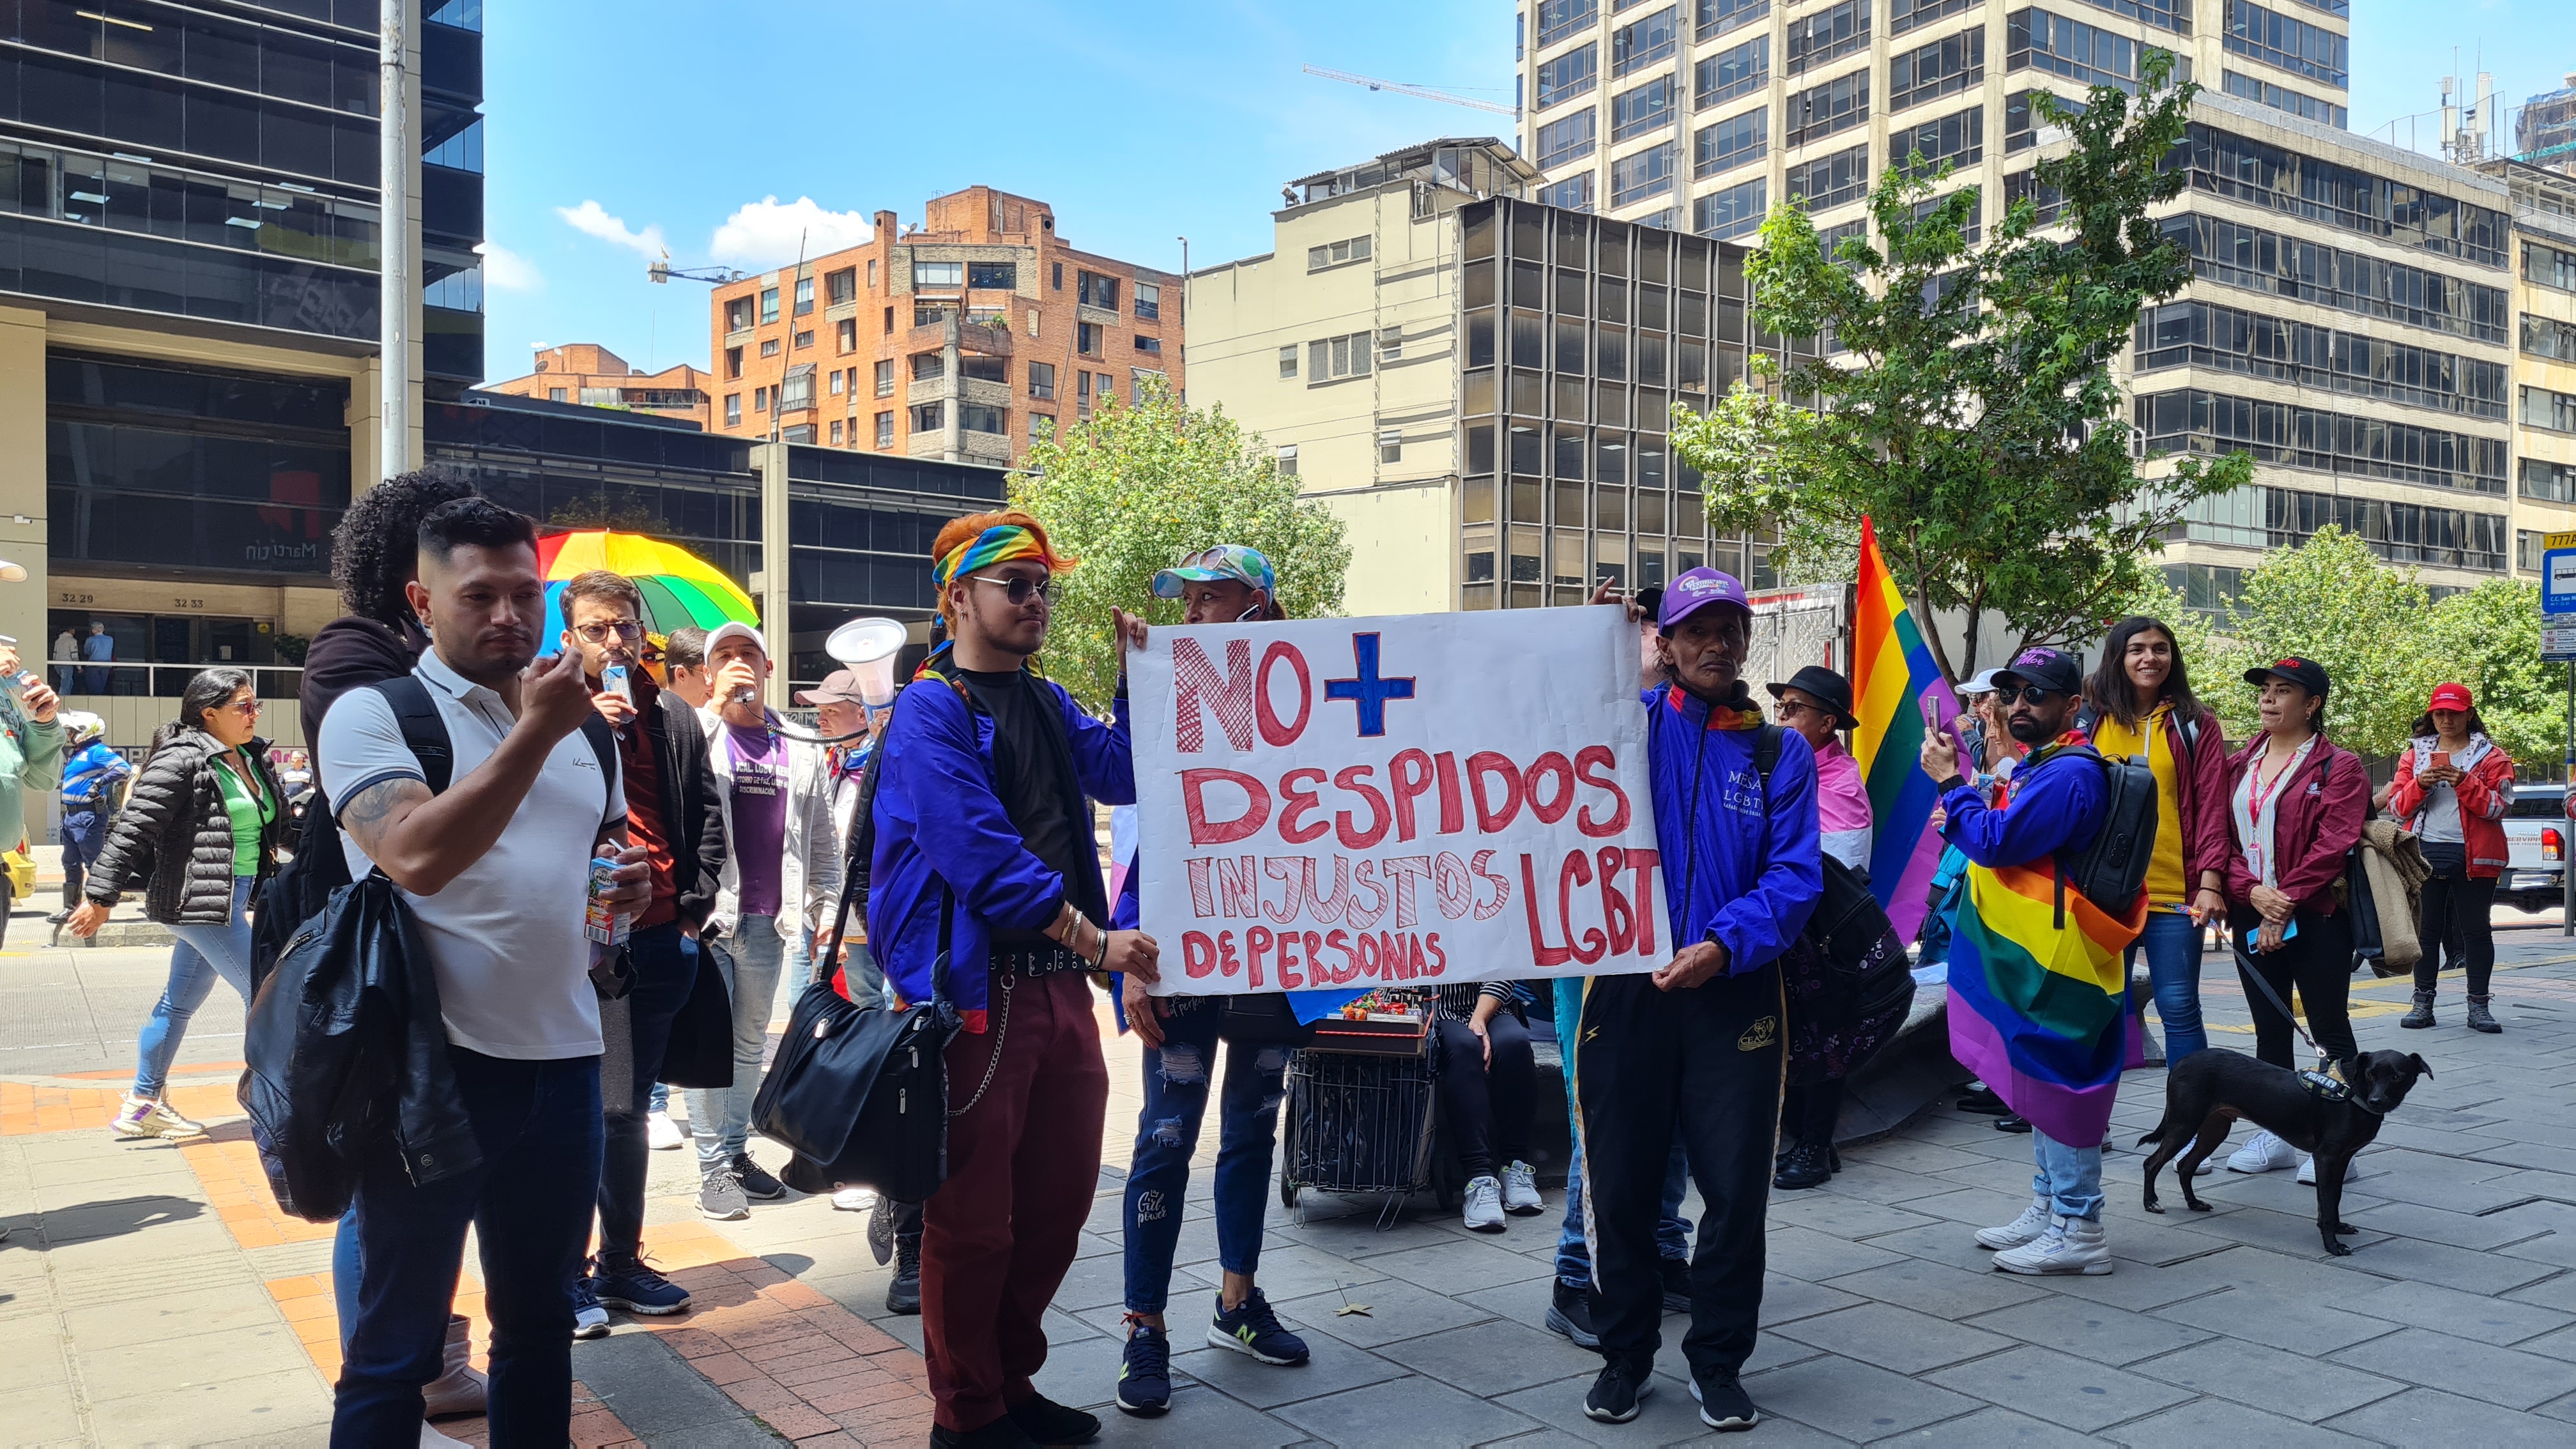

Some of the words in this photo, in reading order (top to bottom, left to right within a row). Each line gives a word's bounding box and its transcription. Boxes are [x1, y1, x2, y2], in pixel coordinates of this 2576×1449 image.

[62, 593, 75, 602] 32
[79, 594, 93, 603] 29
[174, 599, 187, 608] 32
[190, 599, 203, 608] 33
[1172, 638, 1312, 753] NO
[1324, 632, 1416, 737] +
[1728, 770, 1762, 791] MESA
[1175, 746, 1632, 849] DESPIDOS
[1183, 850, 1510, 929] INJUSTOS
[1521, 847, 1660, 967] LGBT
[1246, 924, 1446, 990] PERSONAS
[2304, 1071, 2327, 1084] POLICE
[2325, 1078, 2337, 1088] K9
[1138, 1192, 1165, 1212] Girl
